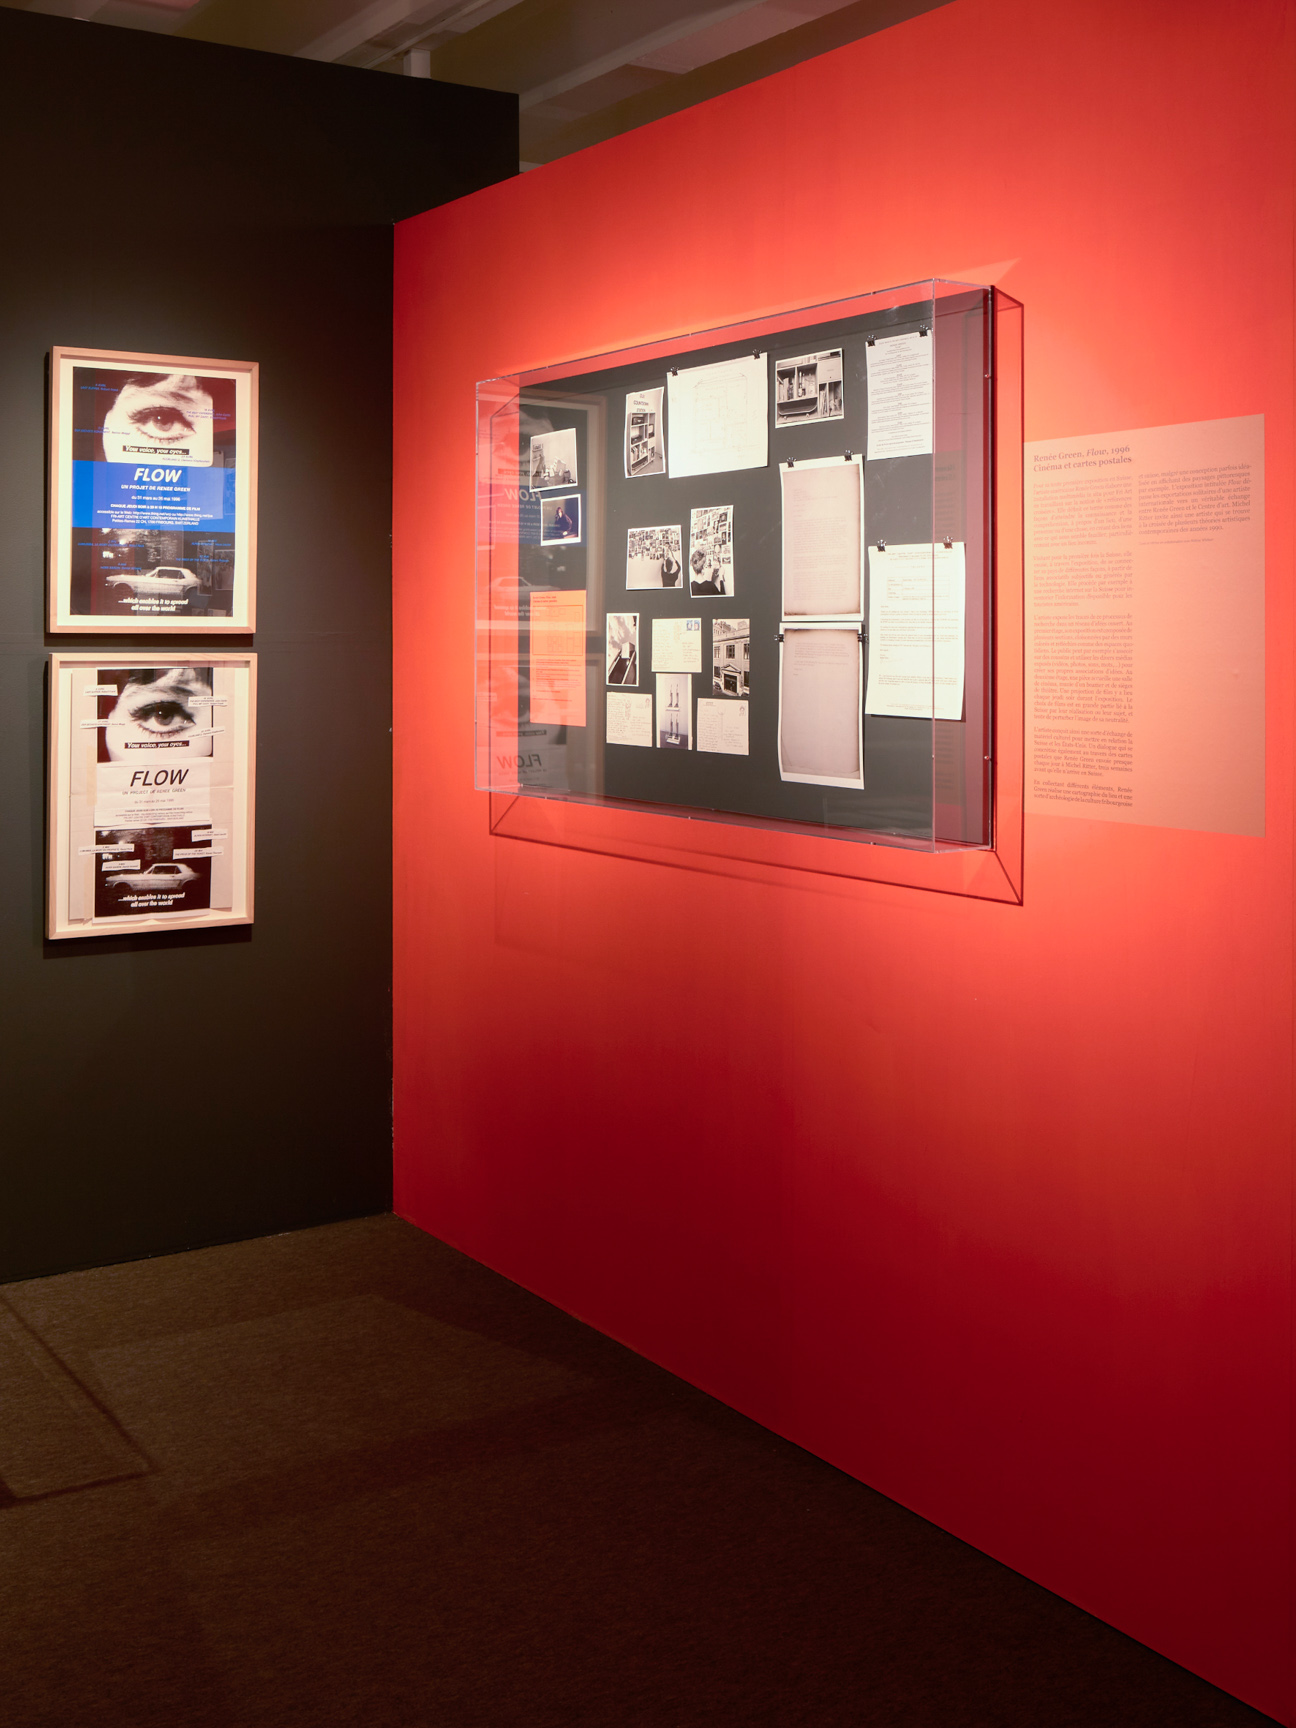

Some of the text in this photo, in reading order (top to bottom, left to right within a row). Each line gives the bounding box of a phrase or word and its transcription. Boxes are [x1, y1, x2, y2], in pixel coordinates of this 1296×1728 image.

[1034, 445, 1130, 462] Renée Green, Flow, 1996
[1034, 463, 1062, 472] Cinéma
[1073, 459, 1097, 468] cartes
[1098, 456, 1132, 467] postales
[1219, 465, 1237, 473] parfois
[134, 467, 182, 483] FLOW
[1228, 493, 1250, 501] échange
[1216, 501, 1230, 509] d'art.
[1221, 515, 1250, 523] artistiques
[1138, 527, 1179, 535] contemporaines
[130, 769, 189, 787] FLOW
[1067, 782, 1089, 790] différents
